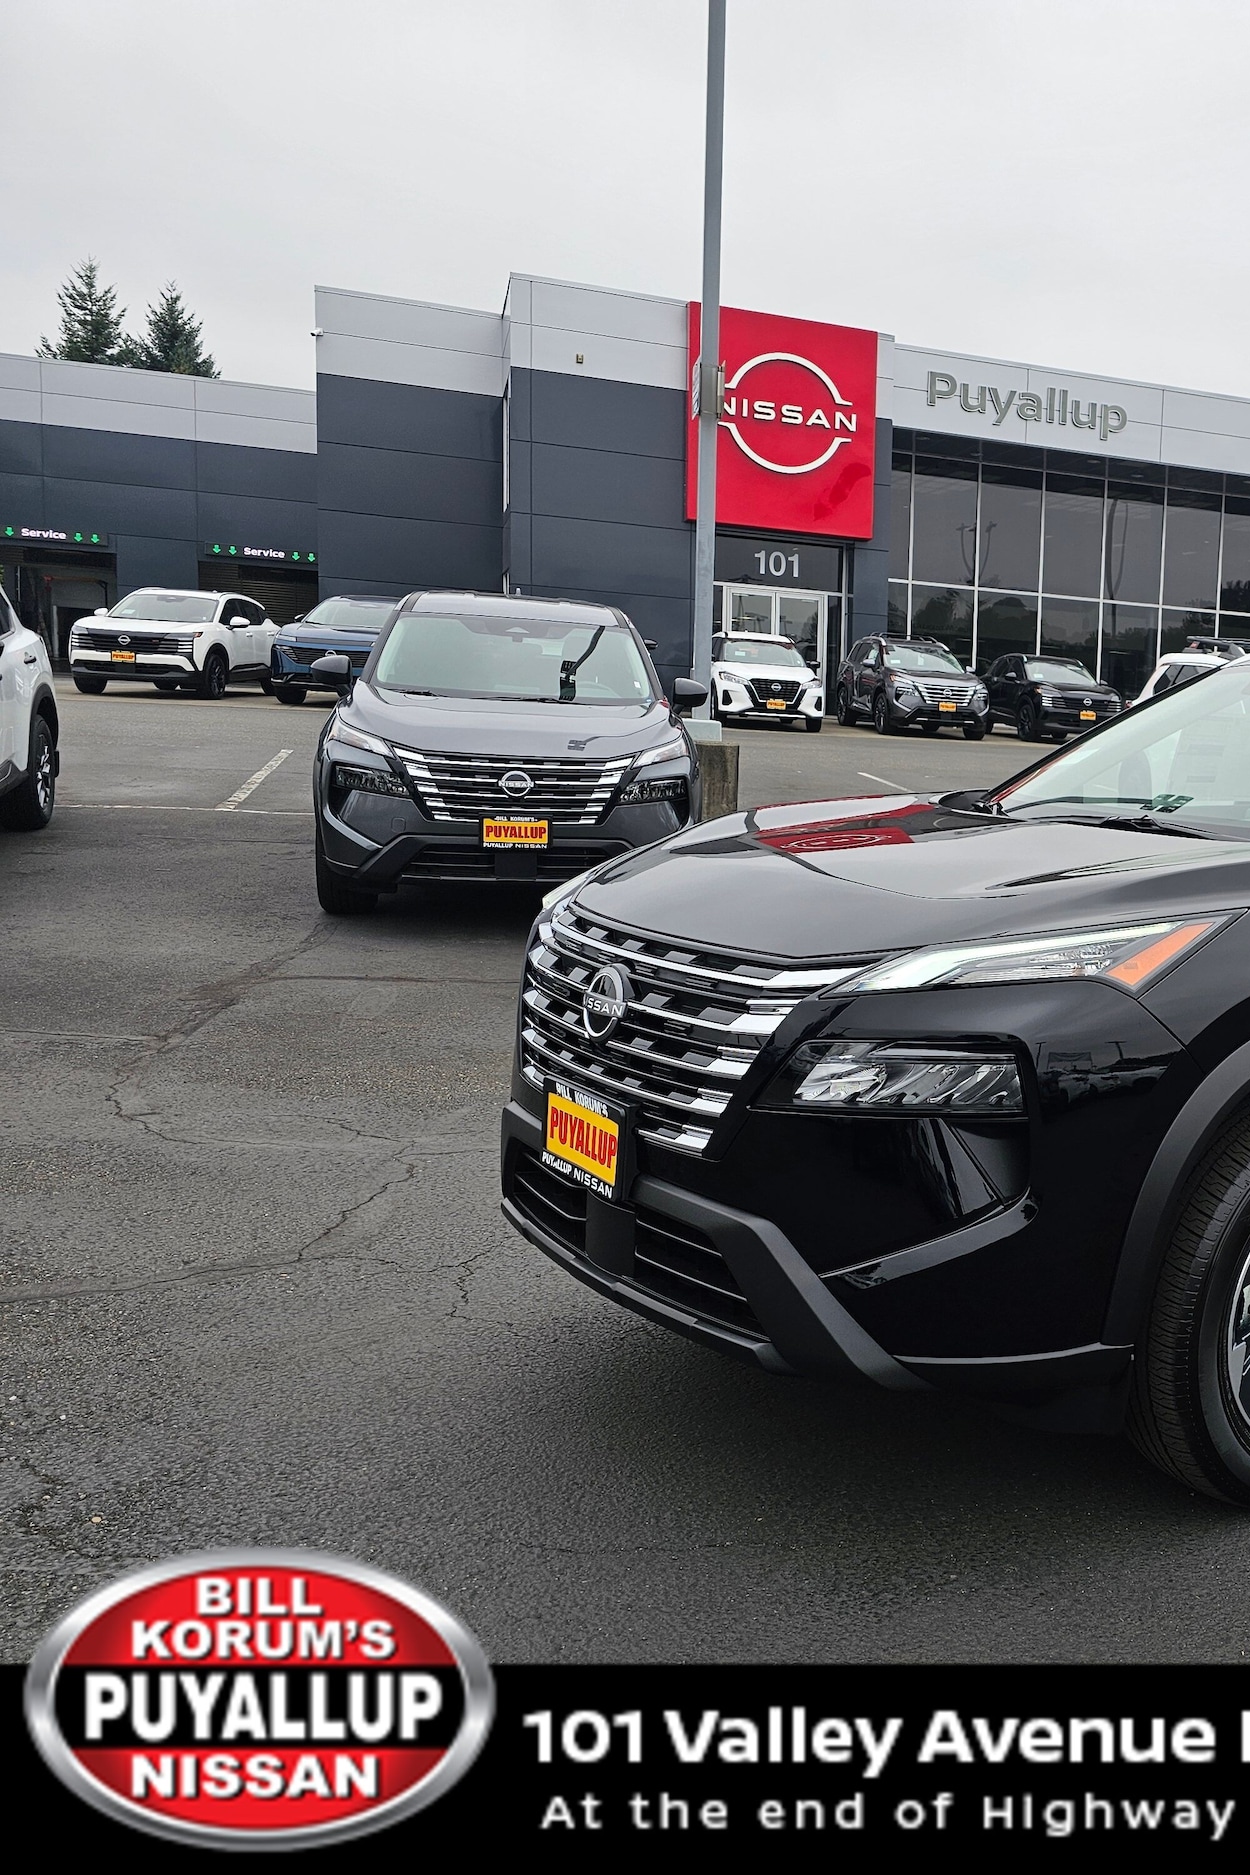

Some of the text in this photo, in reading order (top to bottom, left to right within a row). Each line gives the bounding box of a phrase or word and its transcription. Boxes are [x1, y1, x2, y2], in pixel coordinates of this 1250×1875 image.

[723, 396, 858, 432] NISSAN
[926, 370, 1129, 441] Puyallup
[21, 527, 67, 540] Service
[243, 546, 286, 559] Service
[754, 550, 799, 578] 101
[498, 780, 534, 788] NISSAN
[485, 825, 547, 839] PUYALLUP
[555, 1082, 609, 1117] BILL KORUM'S
[550, 1106, 618, 1168] PUYALLUP
[542, 1151, 613, 1199] PUYALLUP NISSAN
